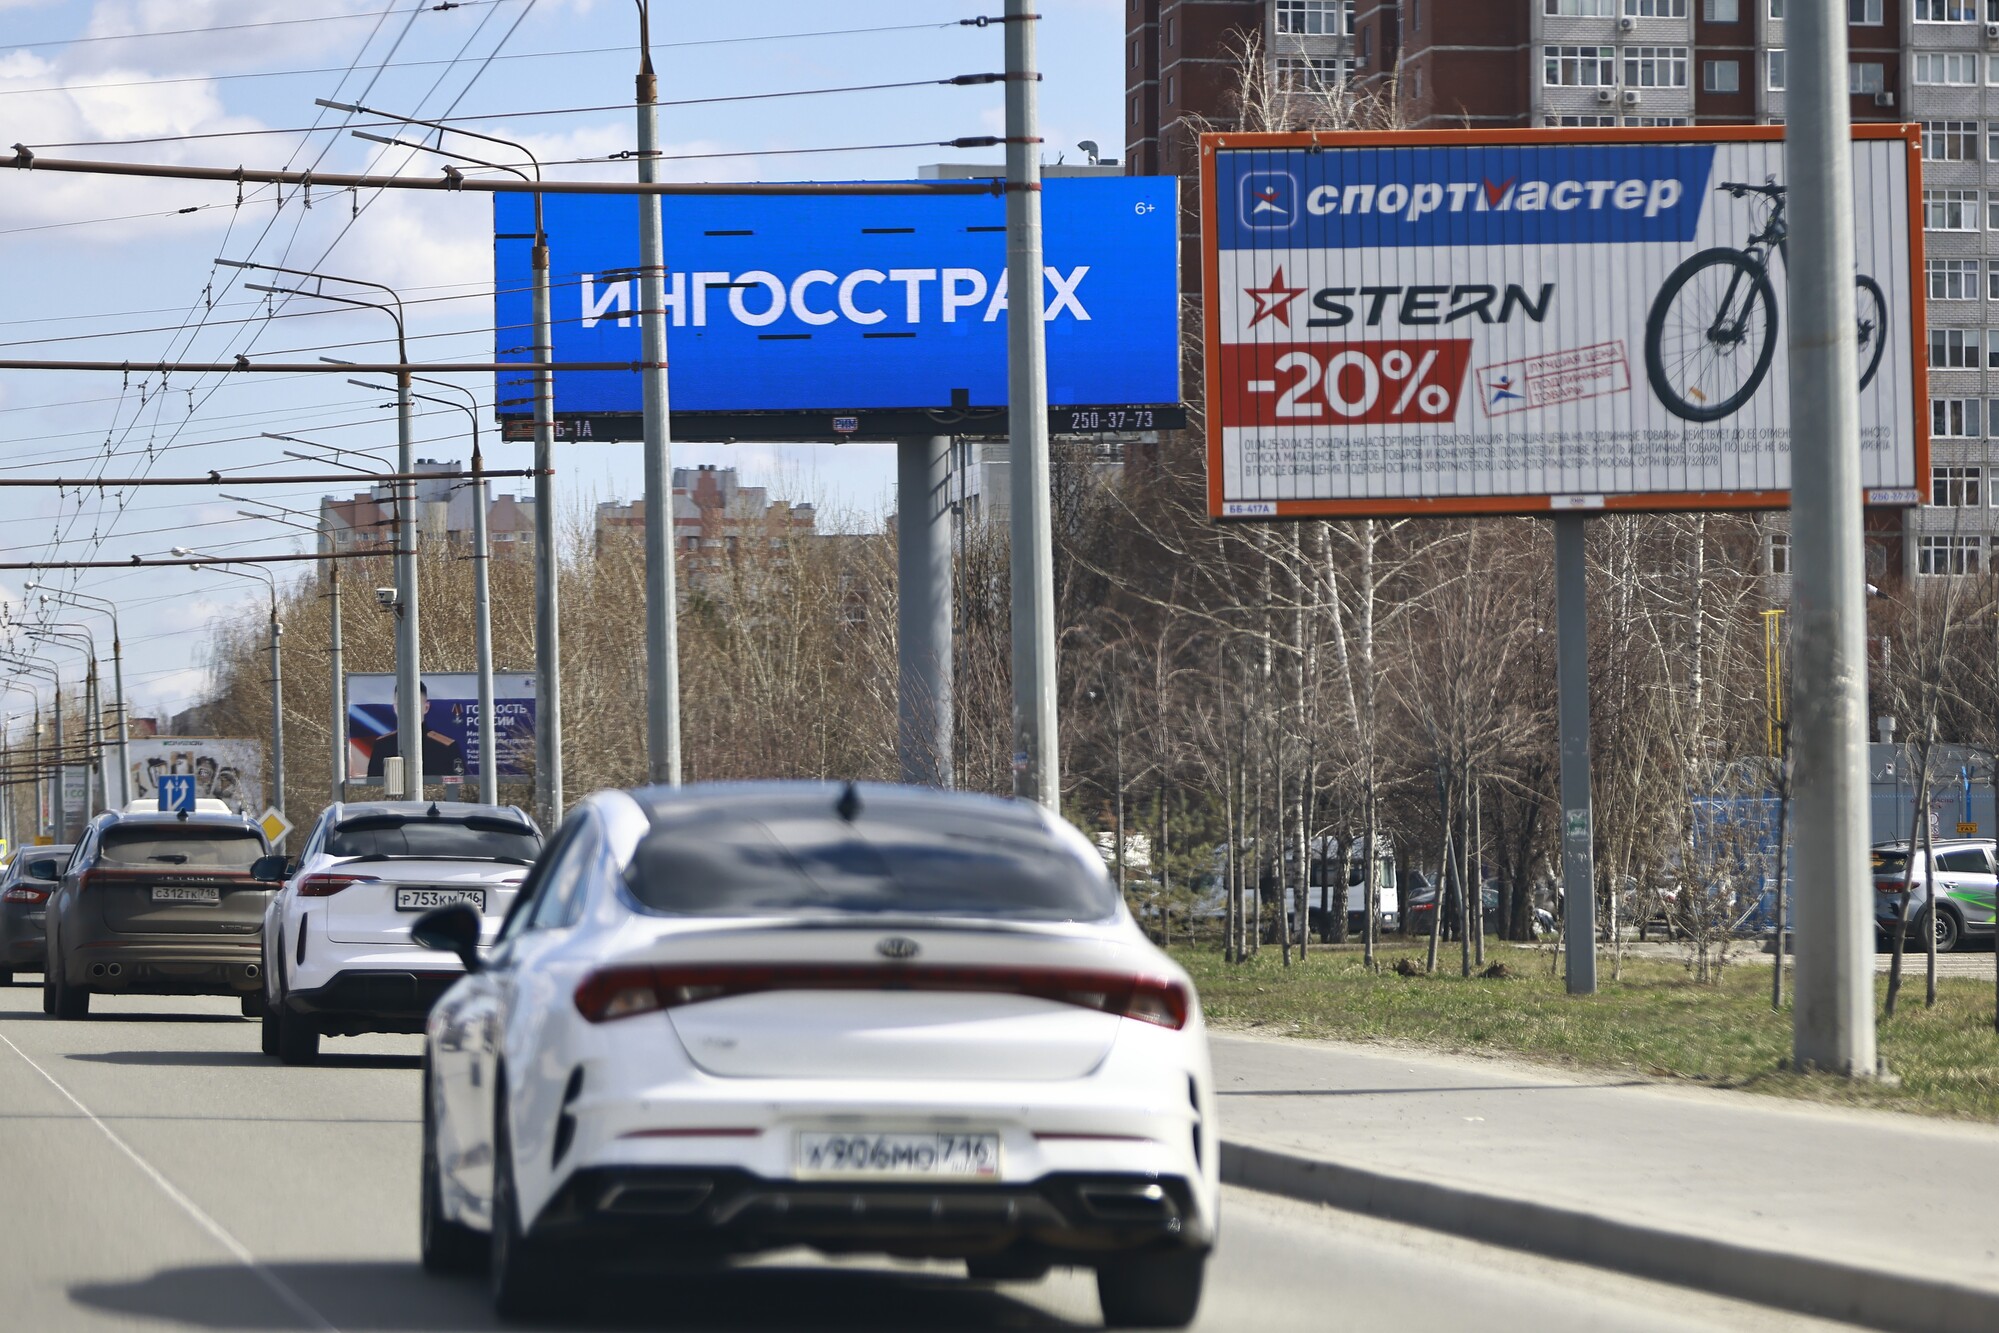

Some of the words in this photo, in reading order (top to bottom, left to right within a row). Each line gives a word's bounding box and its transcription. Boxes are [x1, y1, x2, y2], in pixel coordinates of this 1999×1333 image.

[1135, 201, 1156, 215] 6+
[1306, 177, 1682, 222] спортмастер
[1306, 283, 1555, 327] STERN
[1247, 349, 1450, 417] -20%
[1071, 411, 1153, 429] 250-37-73
[1315, 437, 1350, 449] СКИДКА
[1354, 437, 1366, 448] НА
[1682, 428, 1730, 440] ДЕЙСТВУЕТ
[1732, 428, 1745, 439] ДО
[1760, 427, 1791, 438] ОТМЕН
[1244, 452, 1282, 463] СПИСКА
[1724, 441, 1738, 452] ПО
[1740, 441, 1762, 452] ЦЕНЕ
[1245, 466, 1251, 476] В
[1252, 465, 1286, 476] ГОРОДЕ
[1344, 462, 1410, 474] ПОДРОБНОСТИ
[1412, 462, 1422, 472] НА
[466, 703, 528, 715] ГООСТЬ
